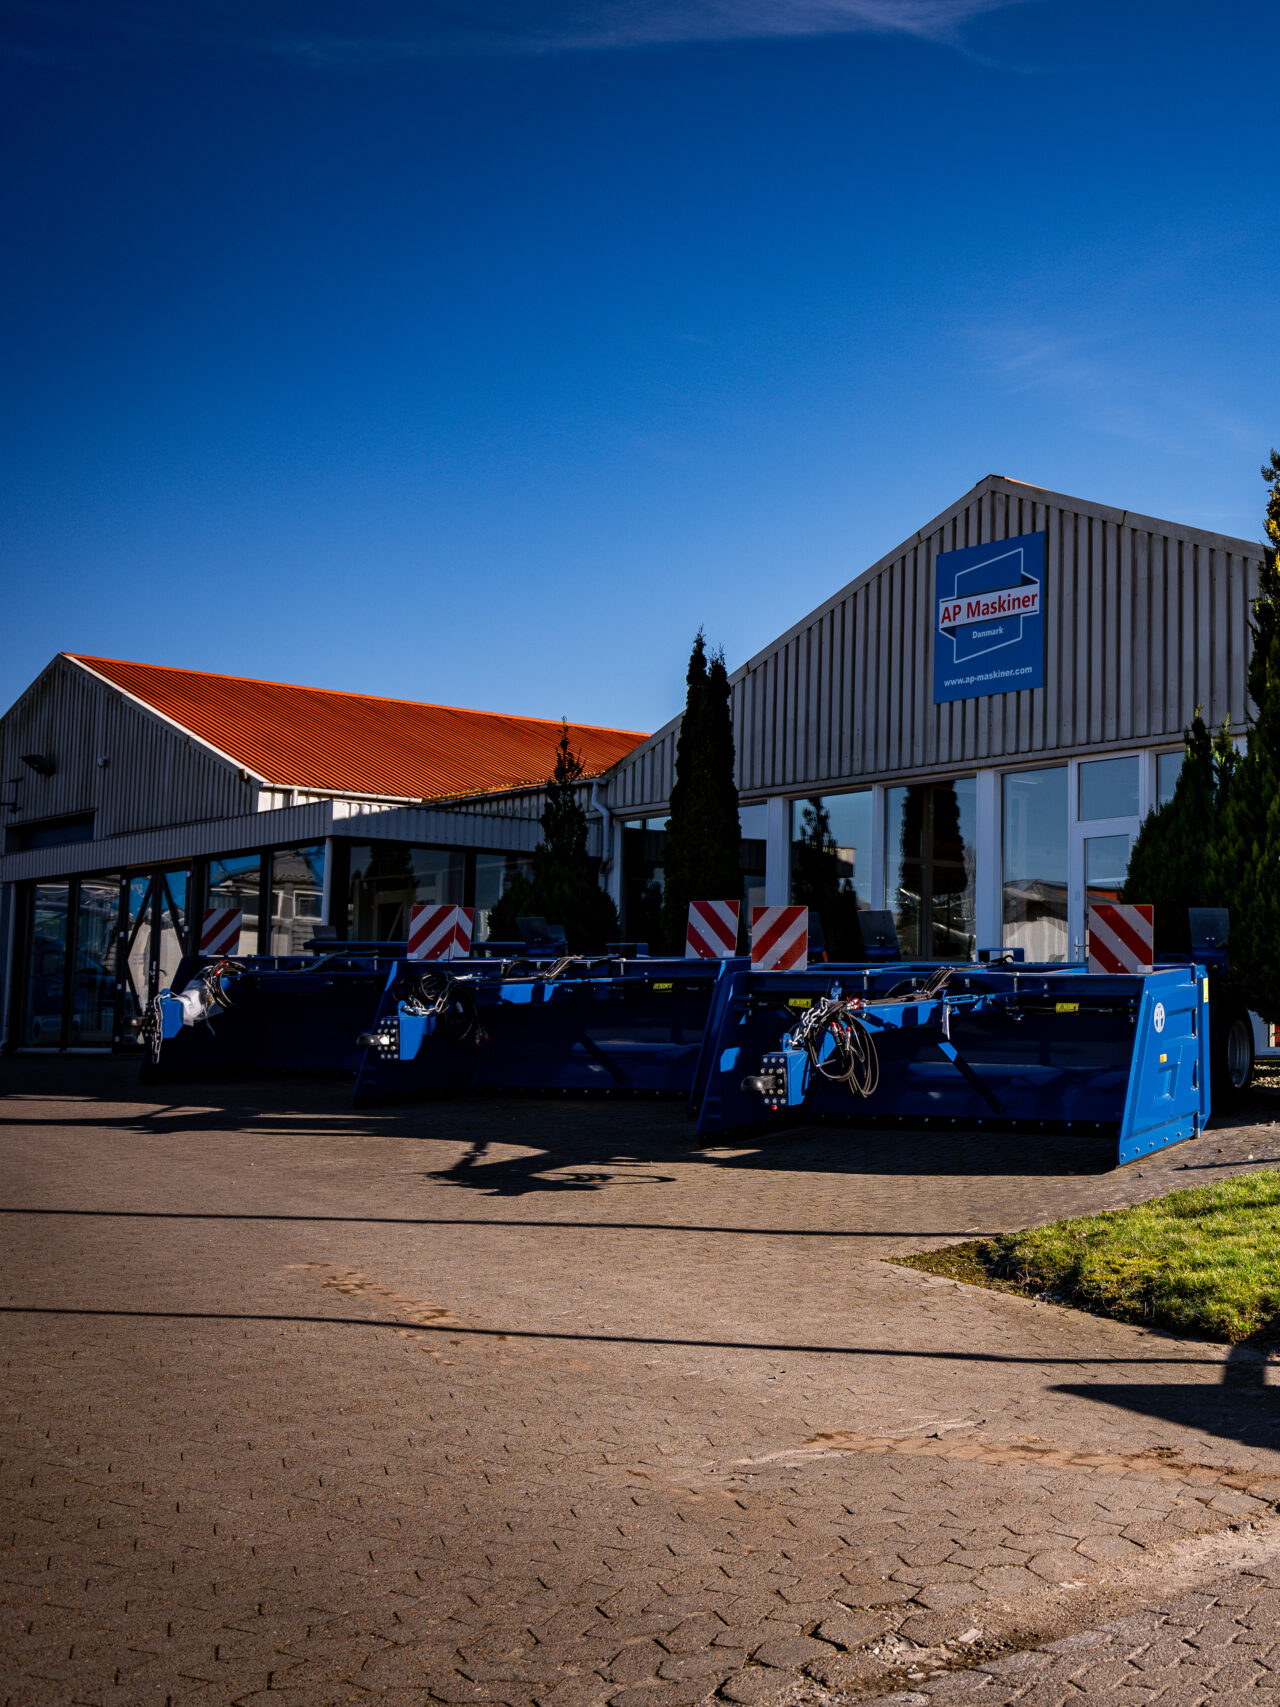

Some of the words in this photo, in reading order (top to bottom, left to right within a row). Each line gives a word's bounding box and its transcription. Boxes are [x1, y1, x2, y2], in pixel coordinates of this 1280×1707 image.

[941, 604, 962, 624] AP
[967, 593, 1038, 619] Maskiner
[972, 626, 1004, 639] Danmark
[944, 666, 1033, 687] www.ap-maskiner.com
